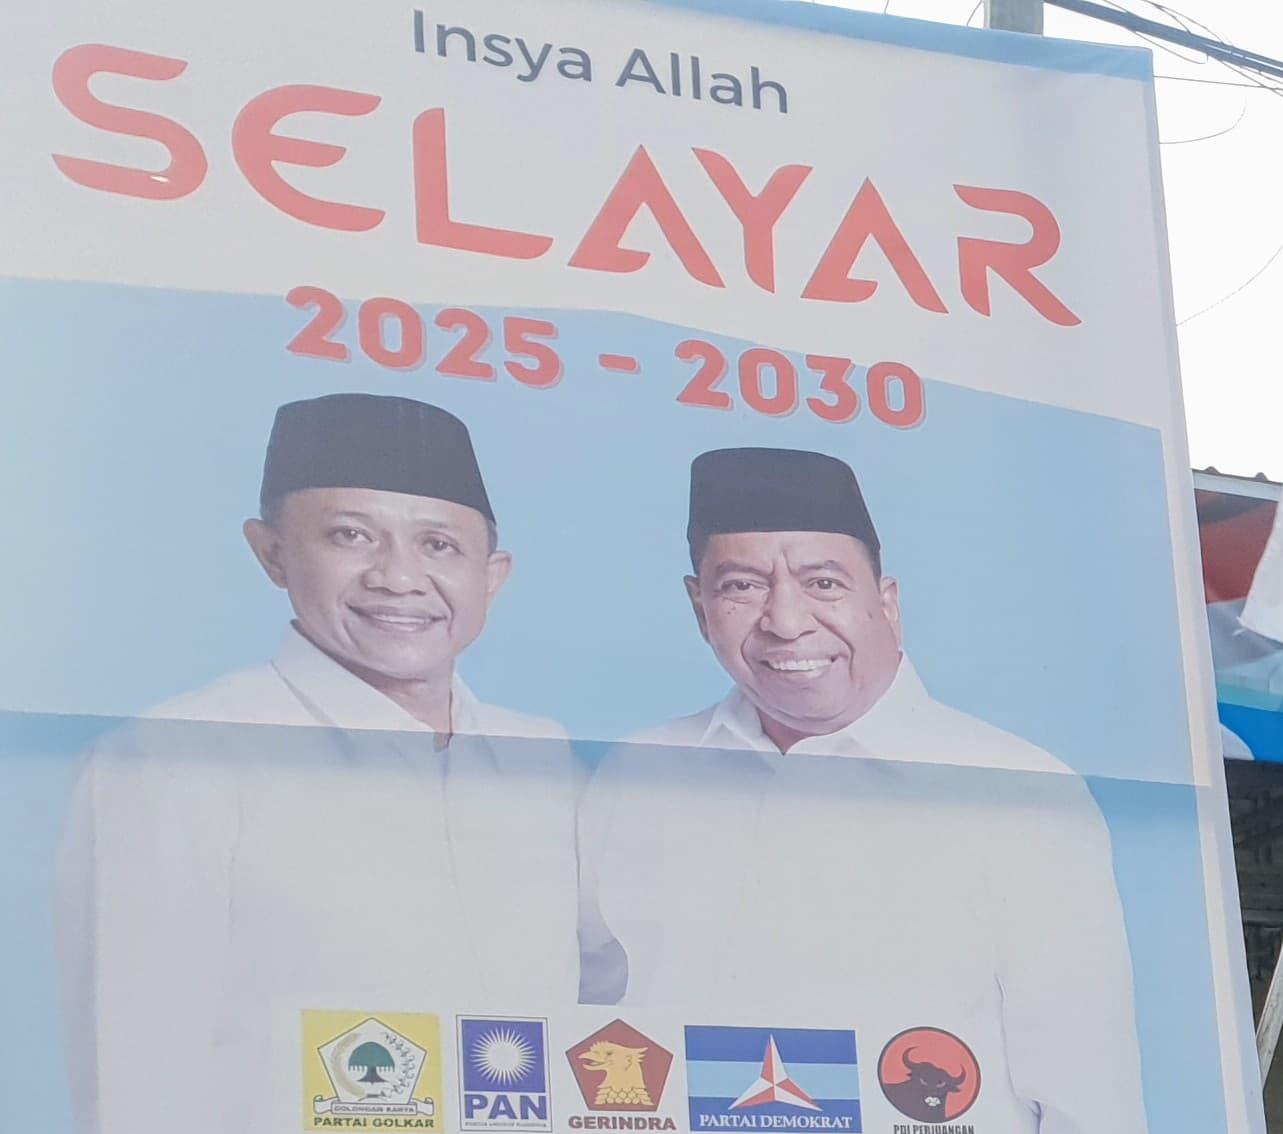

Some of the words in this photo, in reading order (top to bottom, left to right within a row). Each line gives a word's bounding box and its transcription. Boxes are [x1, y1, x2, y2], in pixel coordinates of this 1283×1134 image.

[412, 9, 594, 87] Insya
[616, 45, 790, 115] Allah
[51, 42, 1083, 327] SELAYAR
[285, 285, 565, 388] 2025
[599, 351, 643, 375] -
[674, 337, 928, 430] 2030
[464, 1094, 547, 1120] PAN
[314, 1118, 367, 1127] PARTAI
[373, 1118, 434, 1128] GOLKAR
[568, 1115, 677, 1131] GERINDRA
[700, 1114, 758, 1128] PARTAI
[761, 1115, 852, 1128] DEMOKRAT
